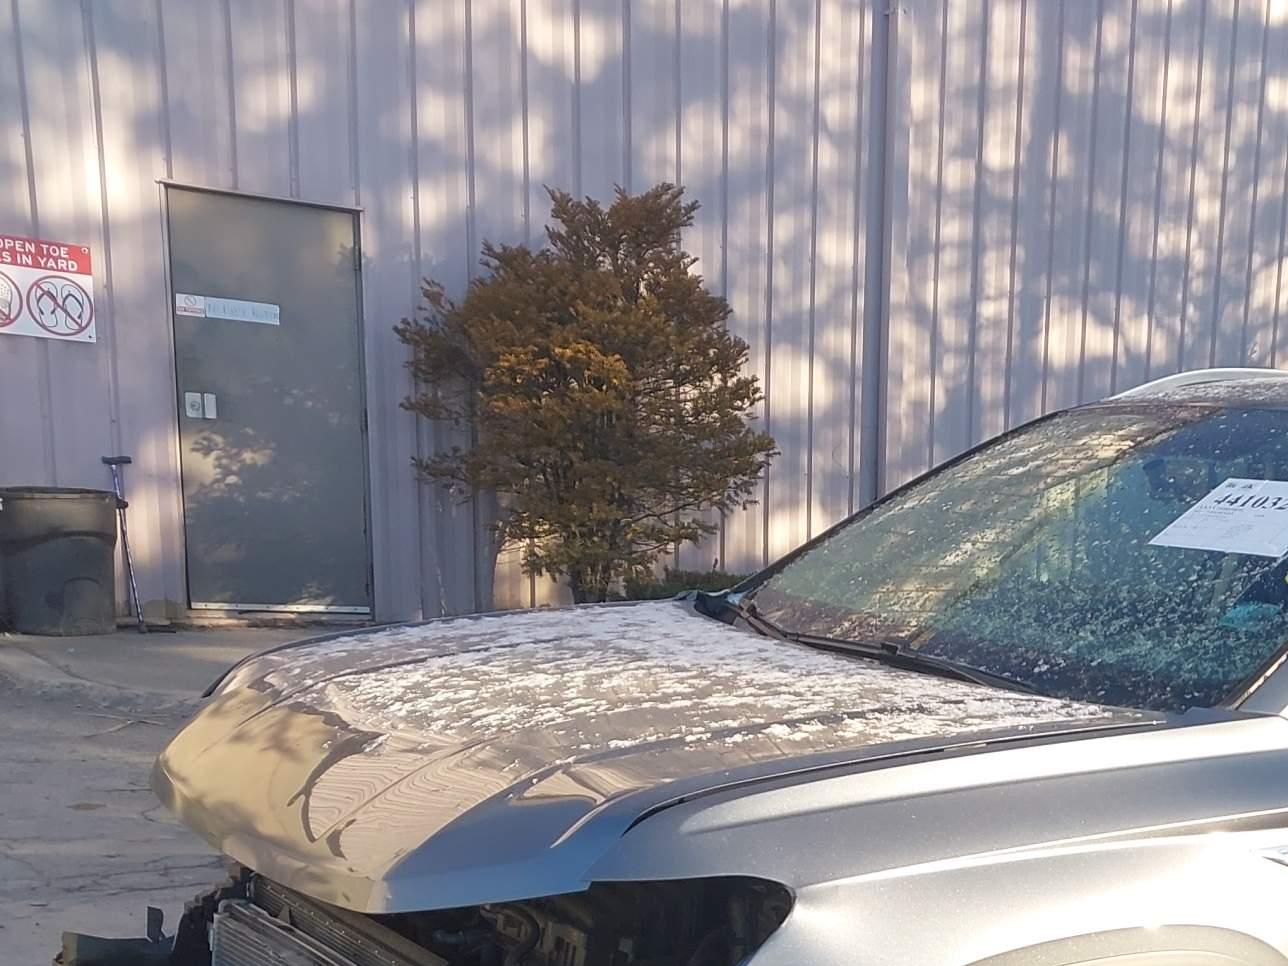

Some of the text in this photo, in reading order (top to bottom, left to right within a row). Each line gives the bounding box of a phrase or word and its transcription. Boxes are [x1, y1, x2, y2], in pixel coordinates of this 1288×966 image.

[40, 243, 69, 259] TOE
[0, 251, 78, 271] S IN YARD
